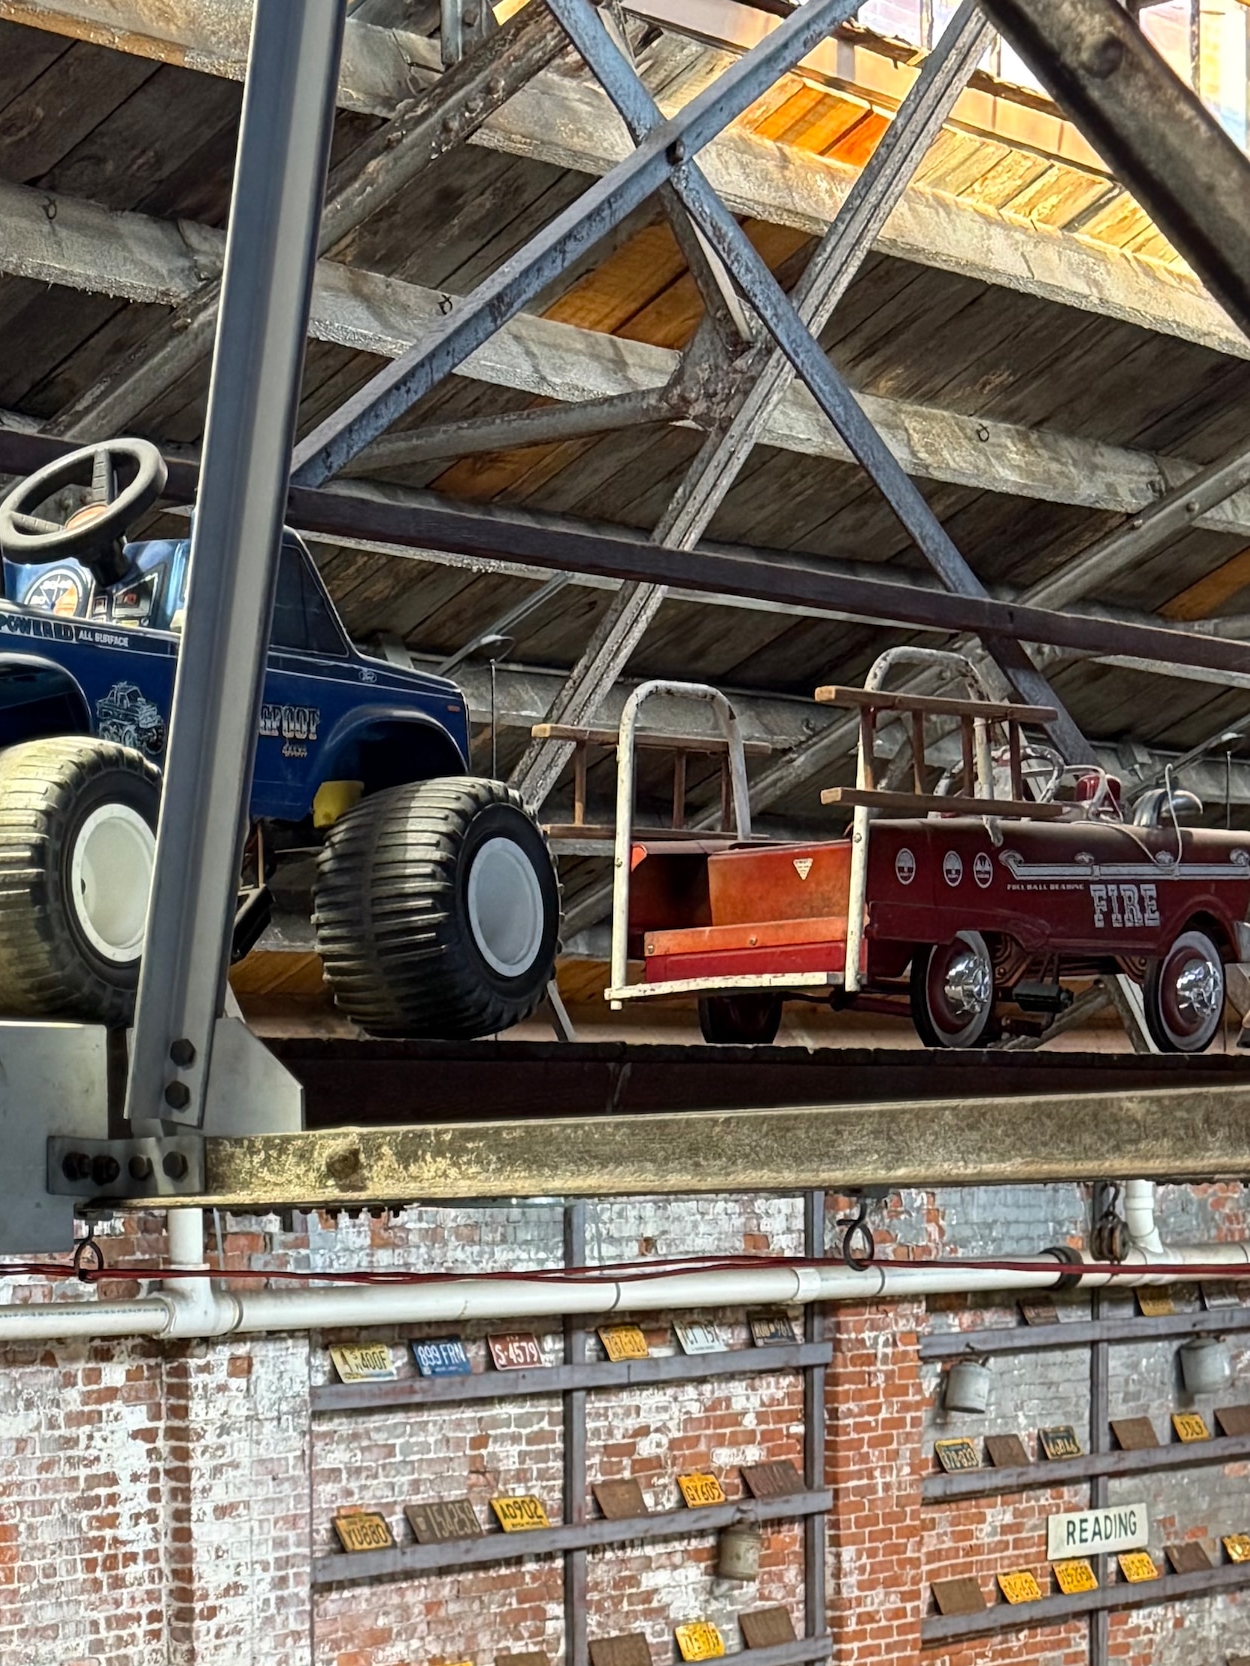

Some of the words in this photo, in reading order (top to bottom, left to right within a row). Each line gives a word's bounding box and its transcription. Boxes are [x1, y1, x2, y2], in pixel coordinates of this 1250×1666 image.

[78, 630, 94, 642] ALL
[1026, 883, 1047, 891] BALL
[1089, 883, 1161, 928] FIRE
[360, 1350, 388, 1371] 400F
[417, 1346, 440, 1366] 899
[440, 1341, 466, 1364] FRN
[684, 1481, 722, 1502] GY605
[426, 1501, 481, 1539] 154259
[1066, 1510, 1137, 1546] READING
